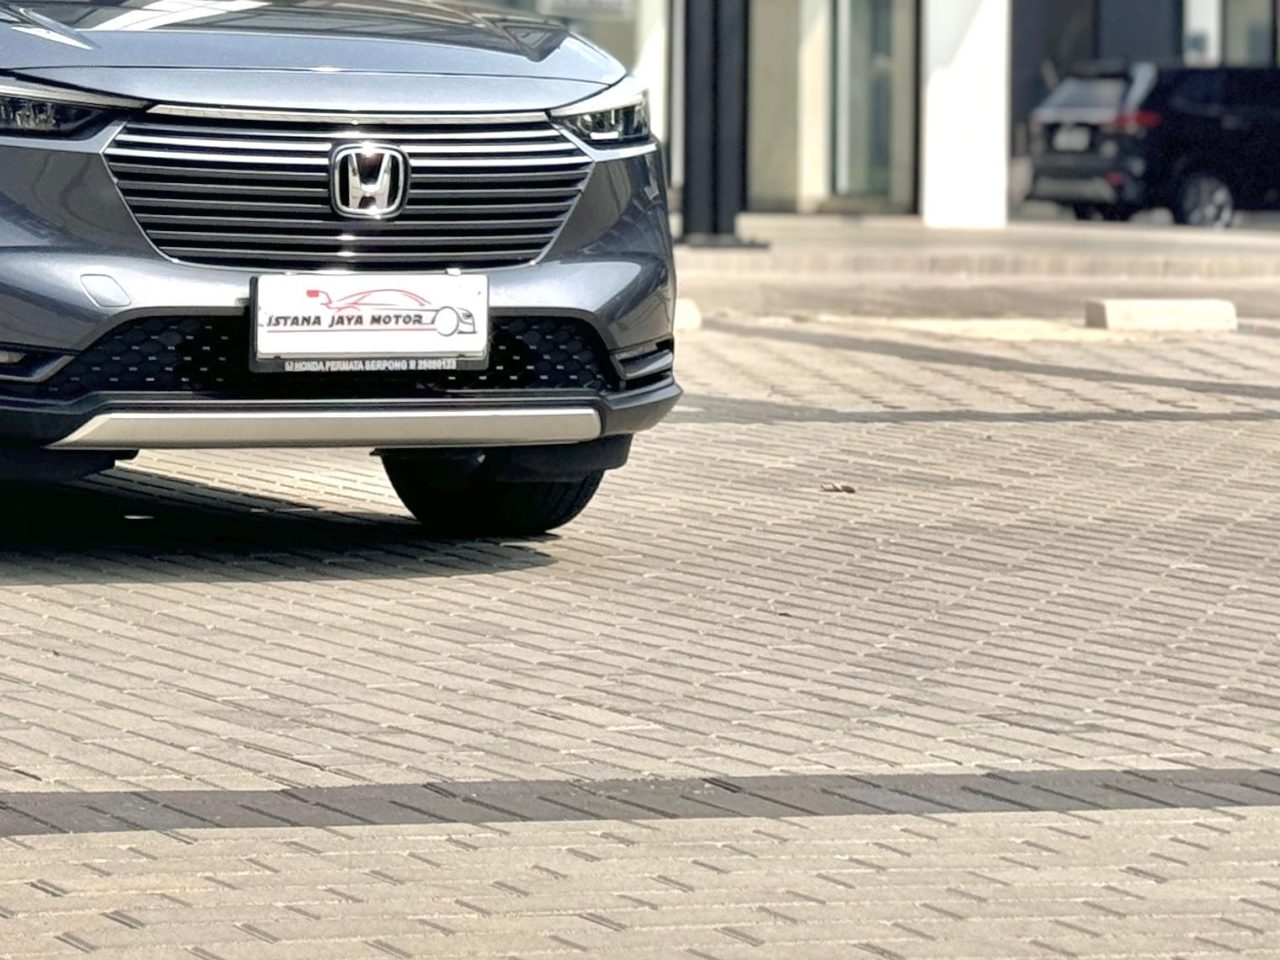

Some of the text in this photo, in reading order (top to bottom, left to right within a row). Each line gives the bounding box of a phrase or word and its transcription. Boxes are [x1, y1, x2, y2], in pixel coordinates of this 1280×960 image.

[267, 314, 423, 328] ISTANA JAYA MOTOR
[295, 360, 324, 371] HONDA
